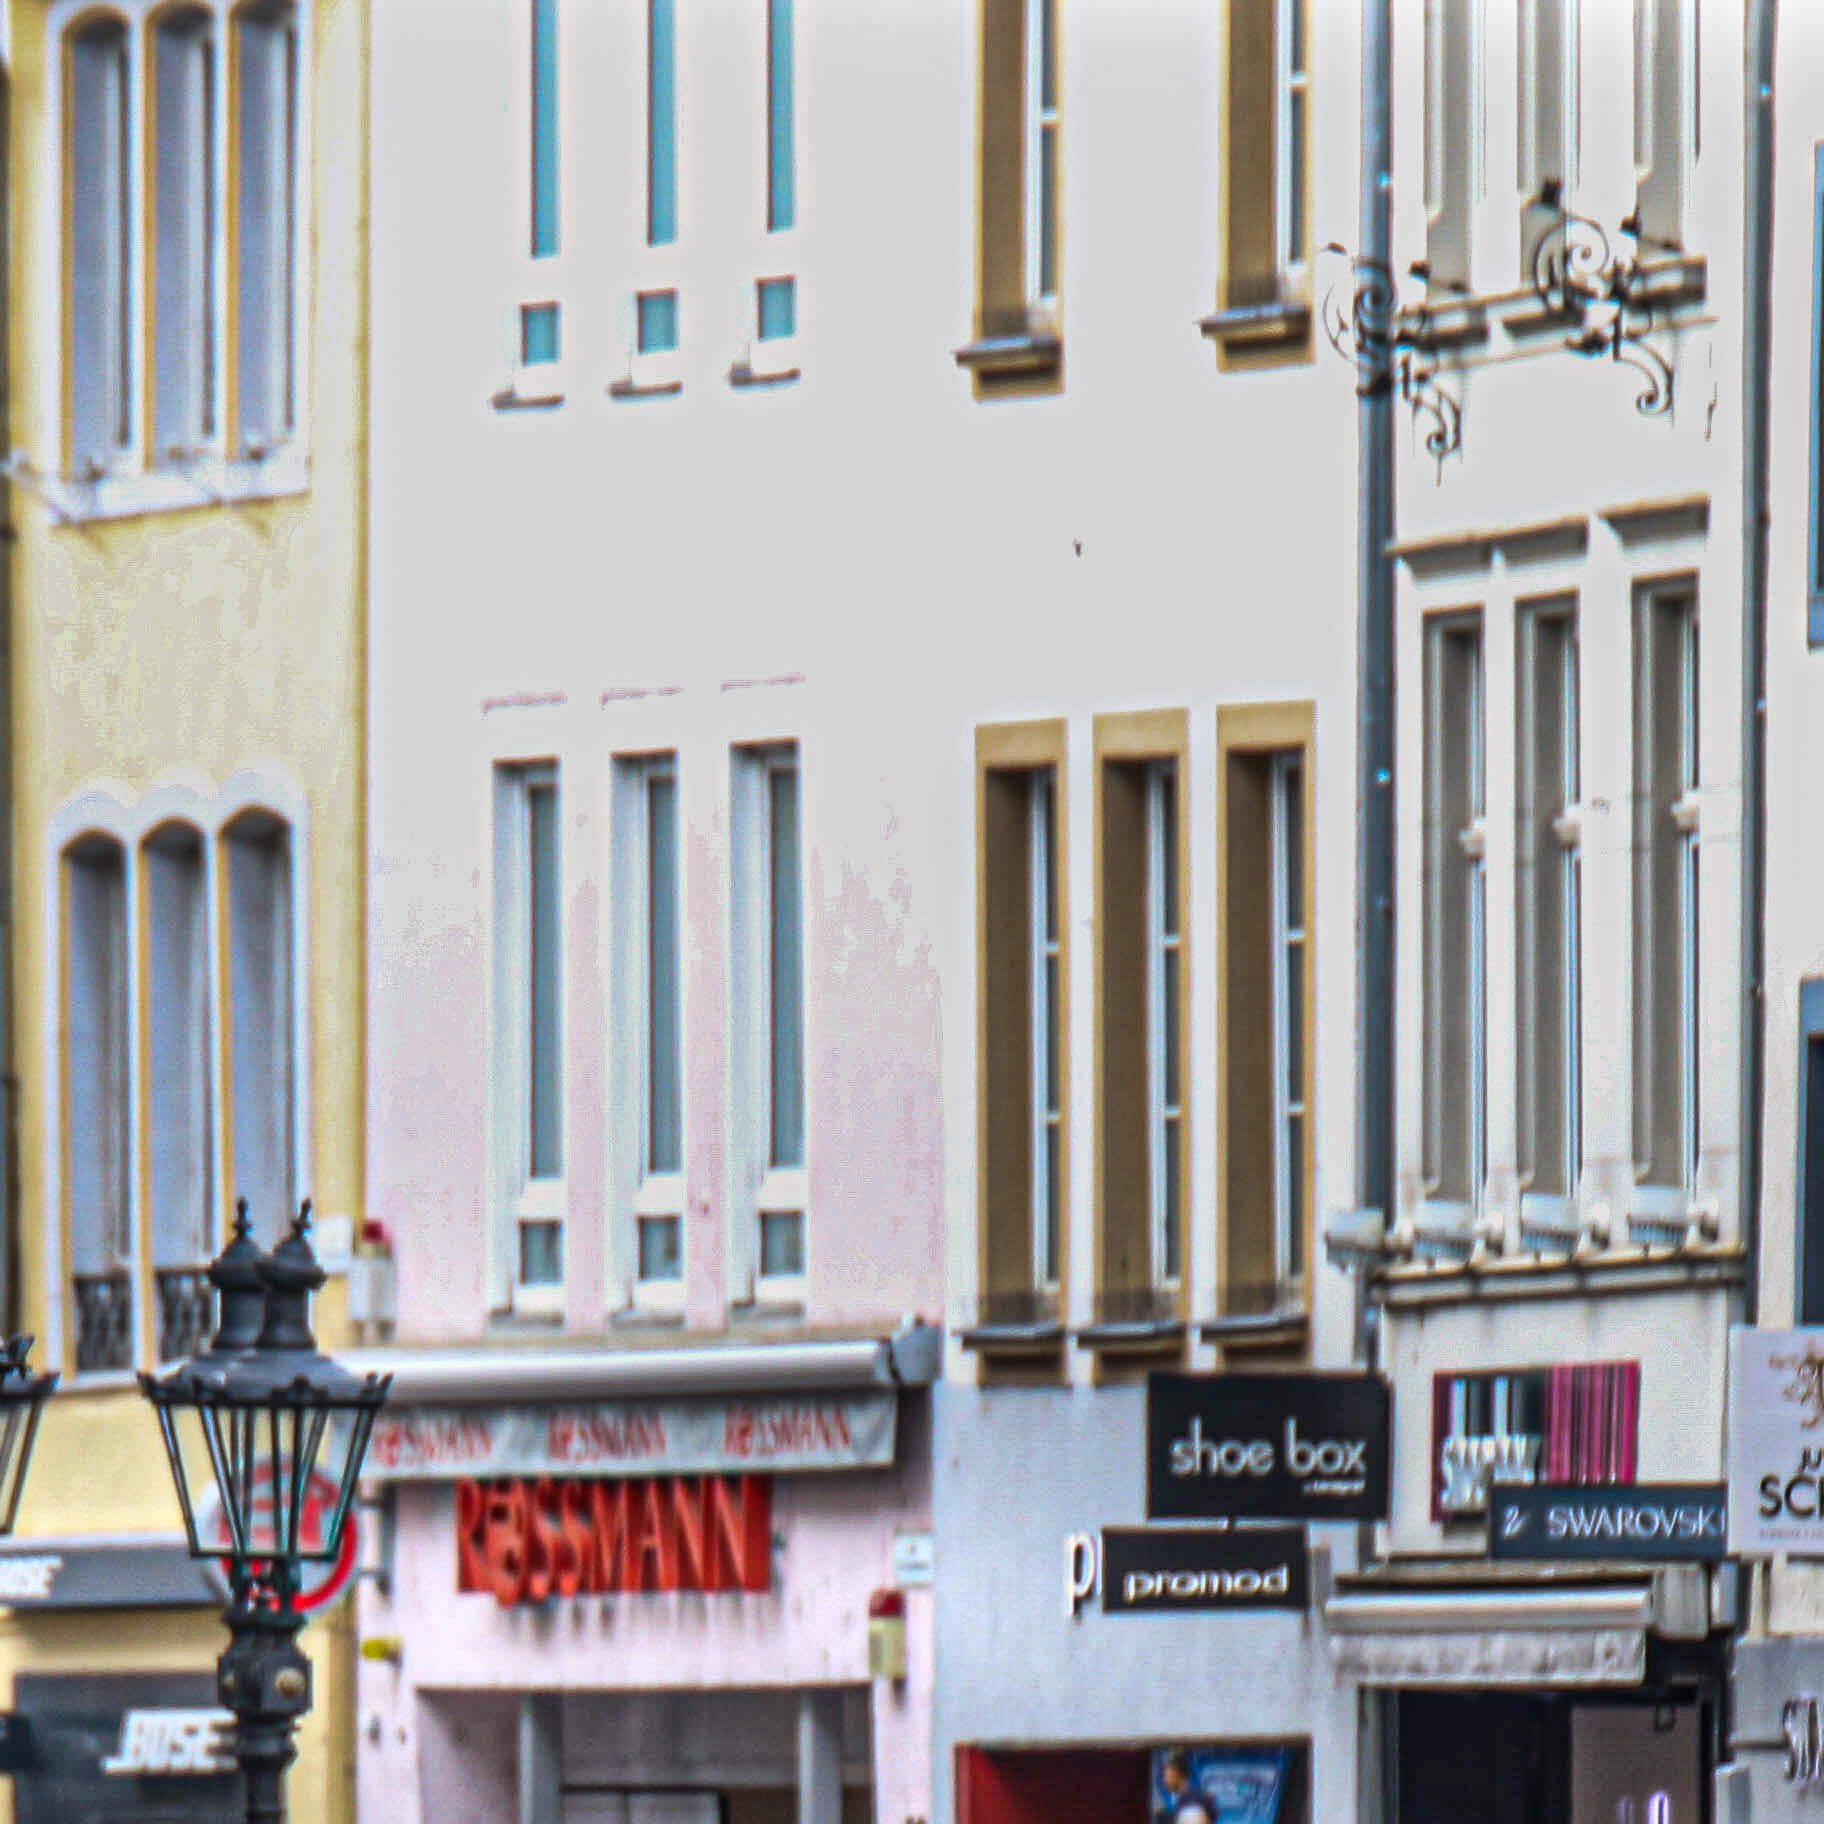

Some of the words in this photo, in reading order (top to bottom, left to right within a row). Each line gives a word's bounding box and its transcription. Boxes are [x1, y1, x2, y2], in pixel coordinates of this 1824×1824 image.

[1171, 1414, 1274, 1477] shoe
[1285, 1414, 1367, 1477] box
[1546, 1504, 1725, 1538] SWAROVSKI
[1124, 1561, 1290, 1601] promod
